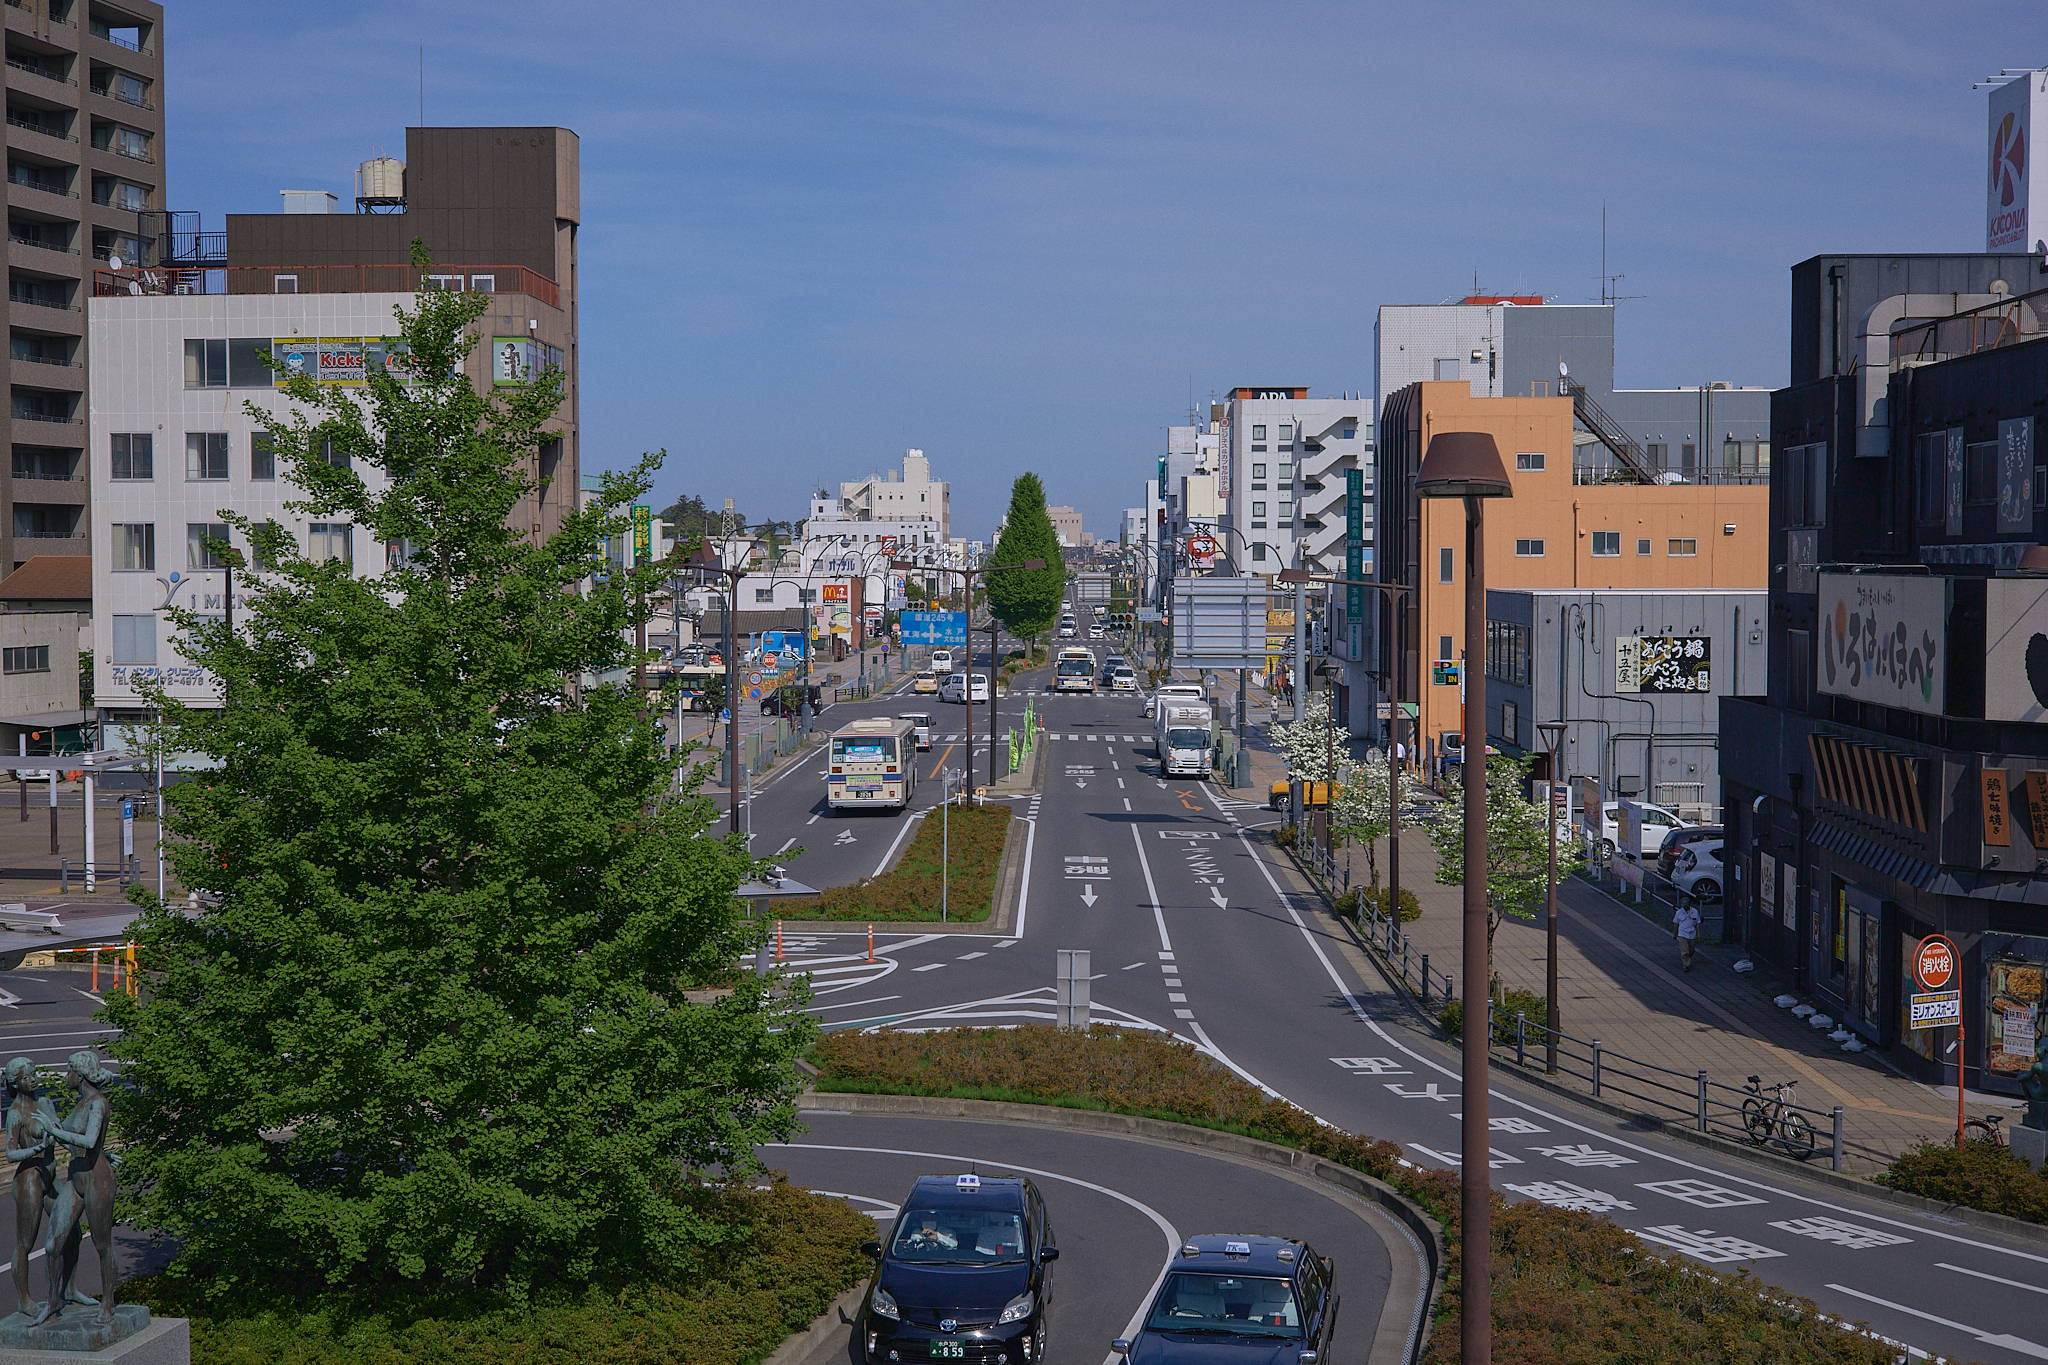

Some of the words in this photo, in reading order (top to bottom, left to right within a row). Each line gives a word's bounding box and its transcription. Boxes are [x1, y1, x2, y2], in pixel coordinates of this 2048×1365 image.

[1989, 208, 2026, 237] KICONA
[320, 352, 363, 367] Kicks
[915, 613, 955, 622] 国道245号
[944, 627, 965, 636] 水戸
[1641, 639, 1705, 659] あんこう鍋
[1824, 609, 1937, 696] いろはにほへと
[1618, 644, 1632, 684] 十五屋
[1641, 659, 1680, 677] あんこう
[112, 667, 127, 676] アイ
[132, 667, 163, 677] メンタル
[167, 667, 204, 677] クリニック
[1447, 675, 1458, 683] IN
[112, 677, 129, 686] TEL
[1653, 675, 1696, 690] 水炊き
[1922, 956, 1950, 975] 消火栓
[1913, 1002, 1958, 1019] ミリオンスポーツ
[1227, 1244, 1238, 1252] TK
